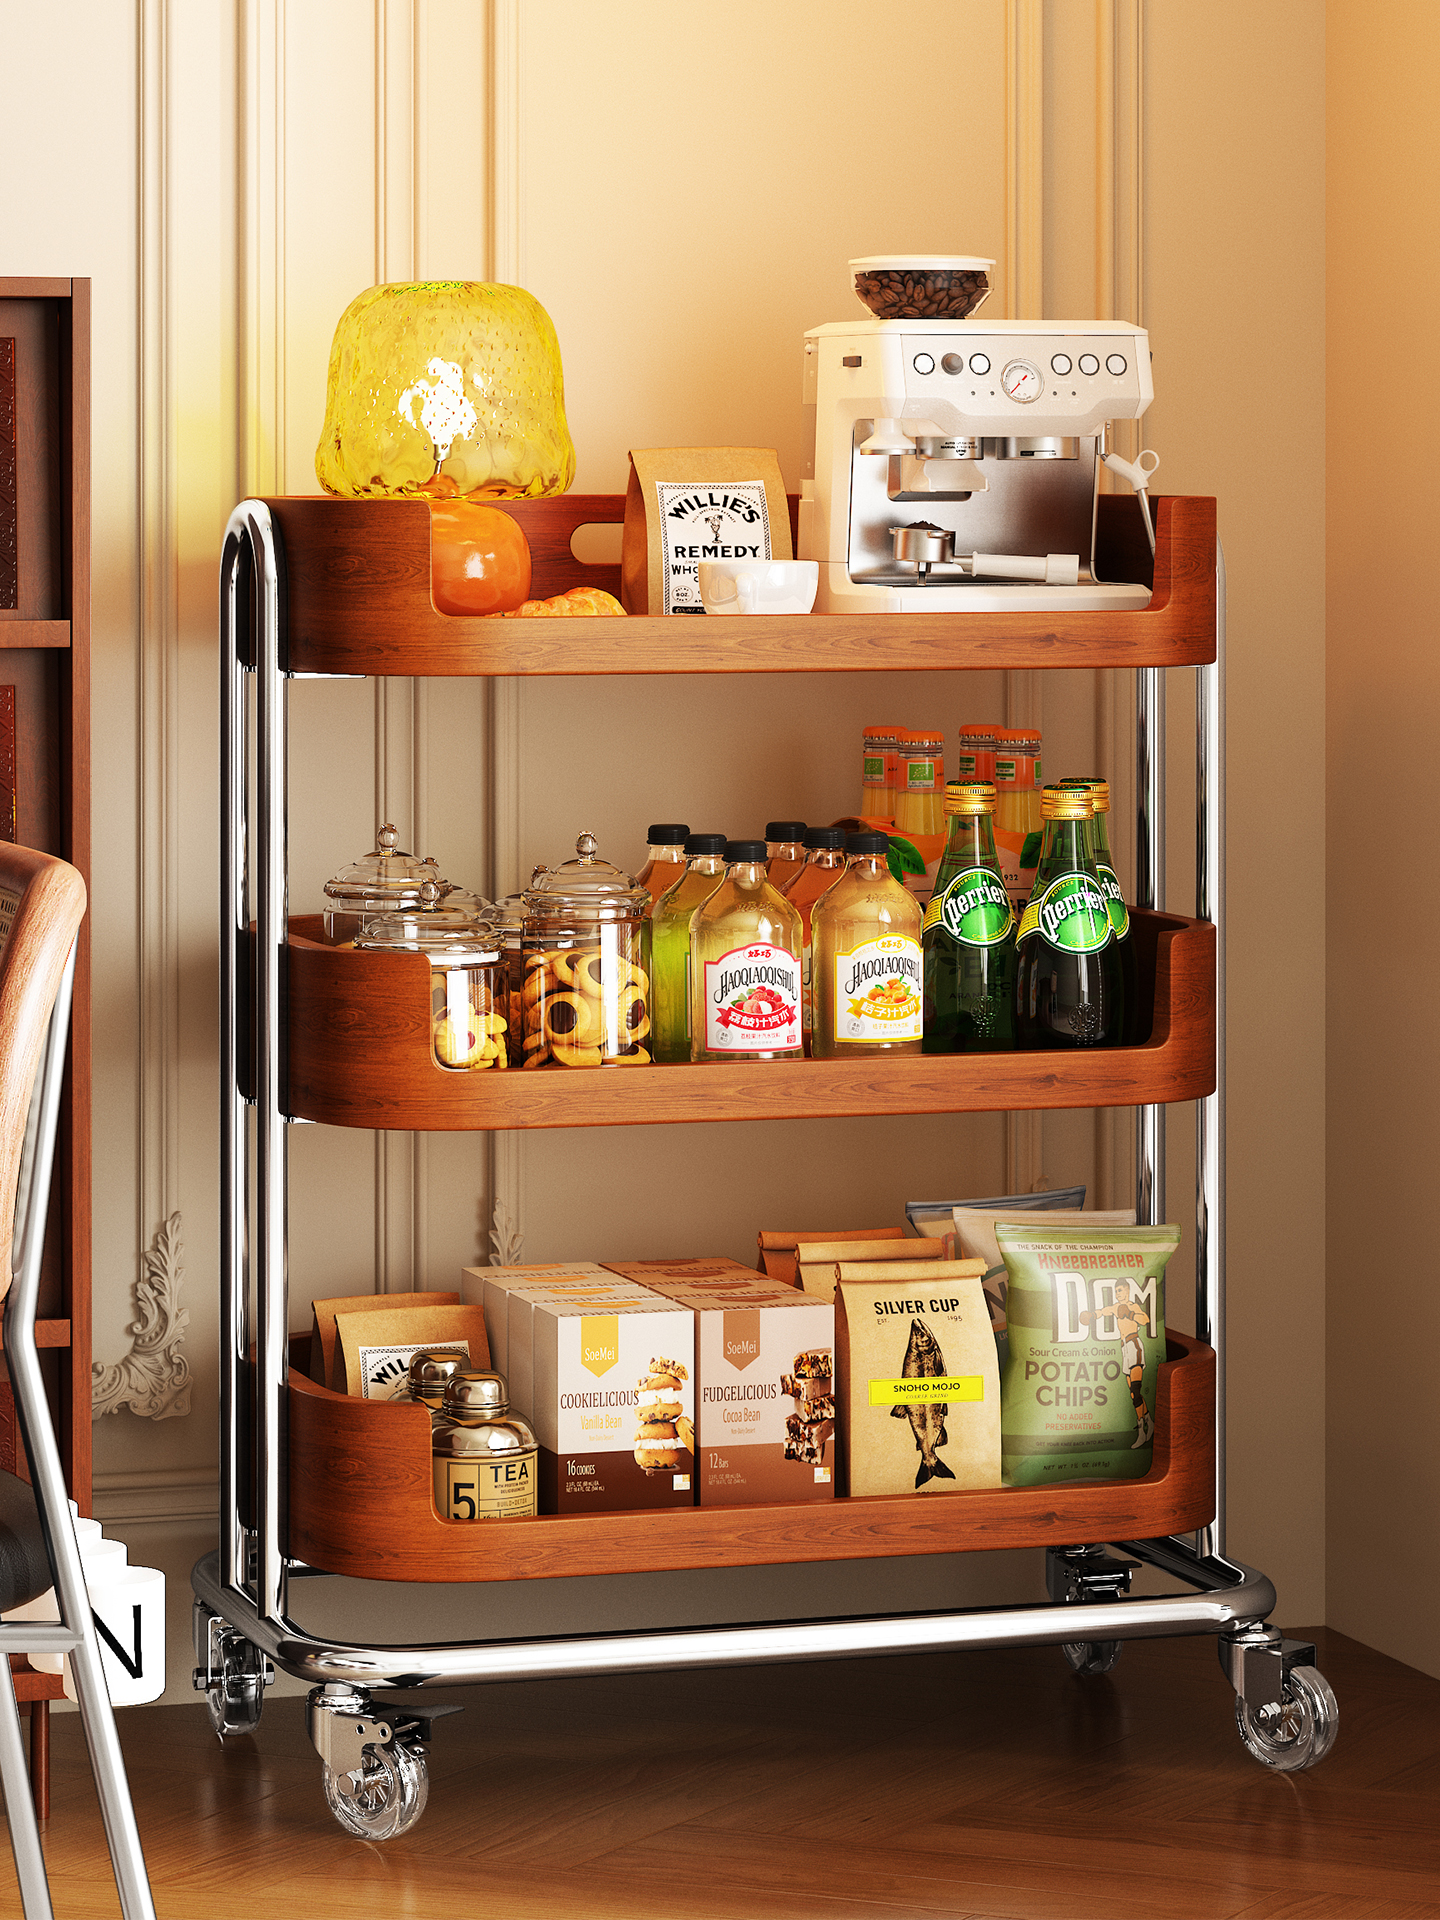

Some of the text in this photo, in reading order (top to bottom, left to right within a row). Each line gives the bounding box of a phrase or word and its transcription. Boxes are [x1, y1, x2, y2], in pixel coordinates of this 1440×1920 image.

[668, 493, 760, 523] WILLIE'S
[674, 546, 760, 558] REMEDY
[945, 881, 1007, 938] perrier
[1043, 886, 1106, 943] perrier
[874, 1298, 960, 1315] SILVER CUP
[1048, 1271, 1158, 1343] DOM
[584, 1347, 615, 1362] SoeMei
[727, 1340, 757, 1355] SoeMei
[1030, 1347, 1116, 1357] Sour Cream & Onion
[1025, 1360, 1121, 1382] POTATO
[703, 1383, 777, 1402] FUDGELICIOUS
[894, 1383, 960, 1392] SNOHO MOJO
[1036, 1385, 1108, 1407] CHIPS
[560, 1390, 640, 1409] COOKIELICIOUS
[580, 1414, 623, 1430] Vanilla Bean
[722, 1407, 761, 1423] Cocoa Bean
[566, 1460, 576, 1476] 16
[709, 1453, 729, 1469] 12 Bars
[490, 1462, 529, 1483] TEA
[453, 1482, 476, 1519] 5
